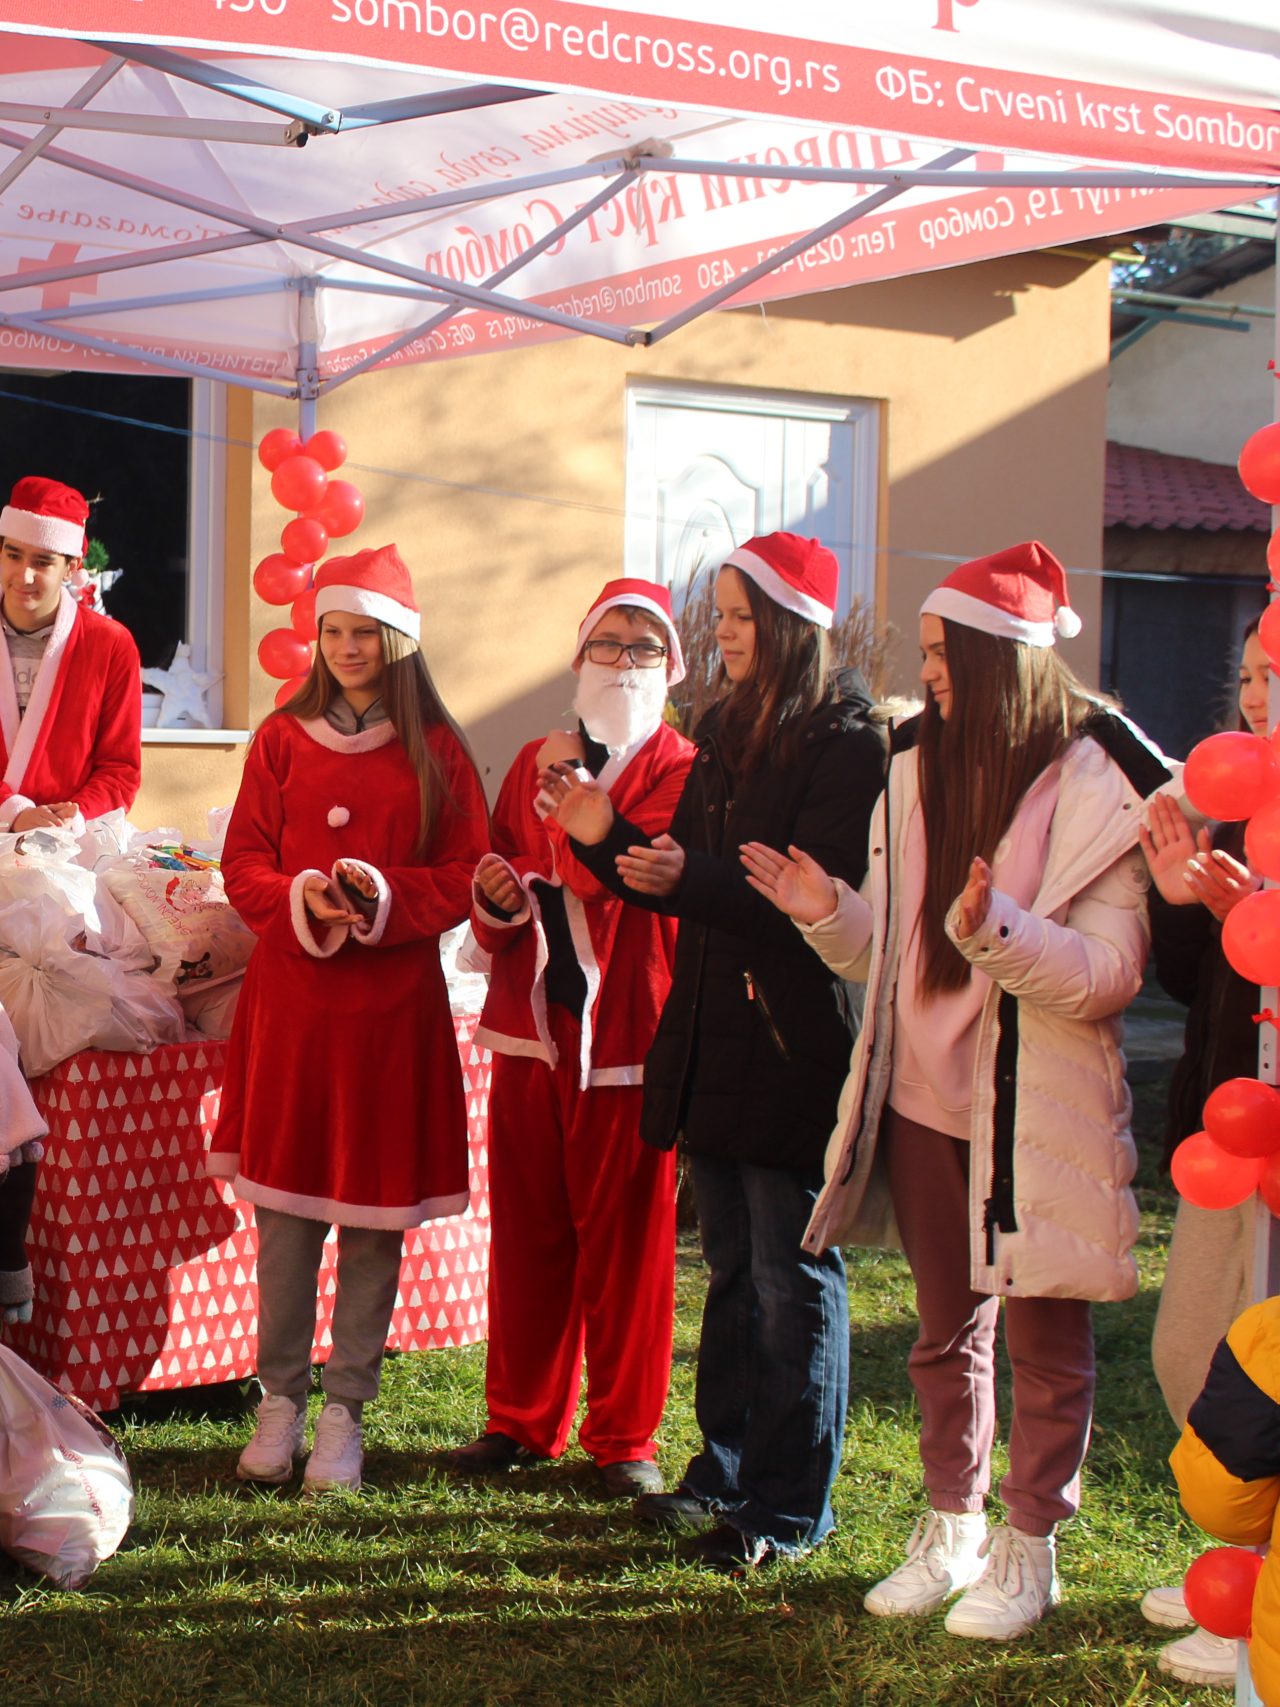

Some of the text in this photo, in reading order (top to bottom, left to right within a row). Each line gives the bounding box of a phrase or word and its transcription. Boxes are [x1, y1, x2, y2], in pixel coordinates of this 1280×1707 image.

[330, 0, 1280, 152] sombor@redcross.org.rs ФБ: Crveni krst Sombor
